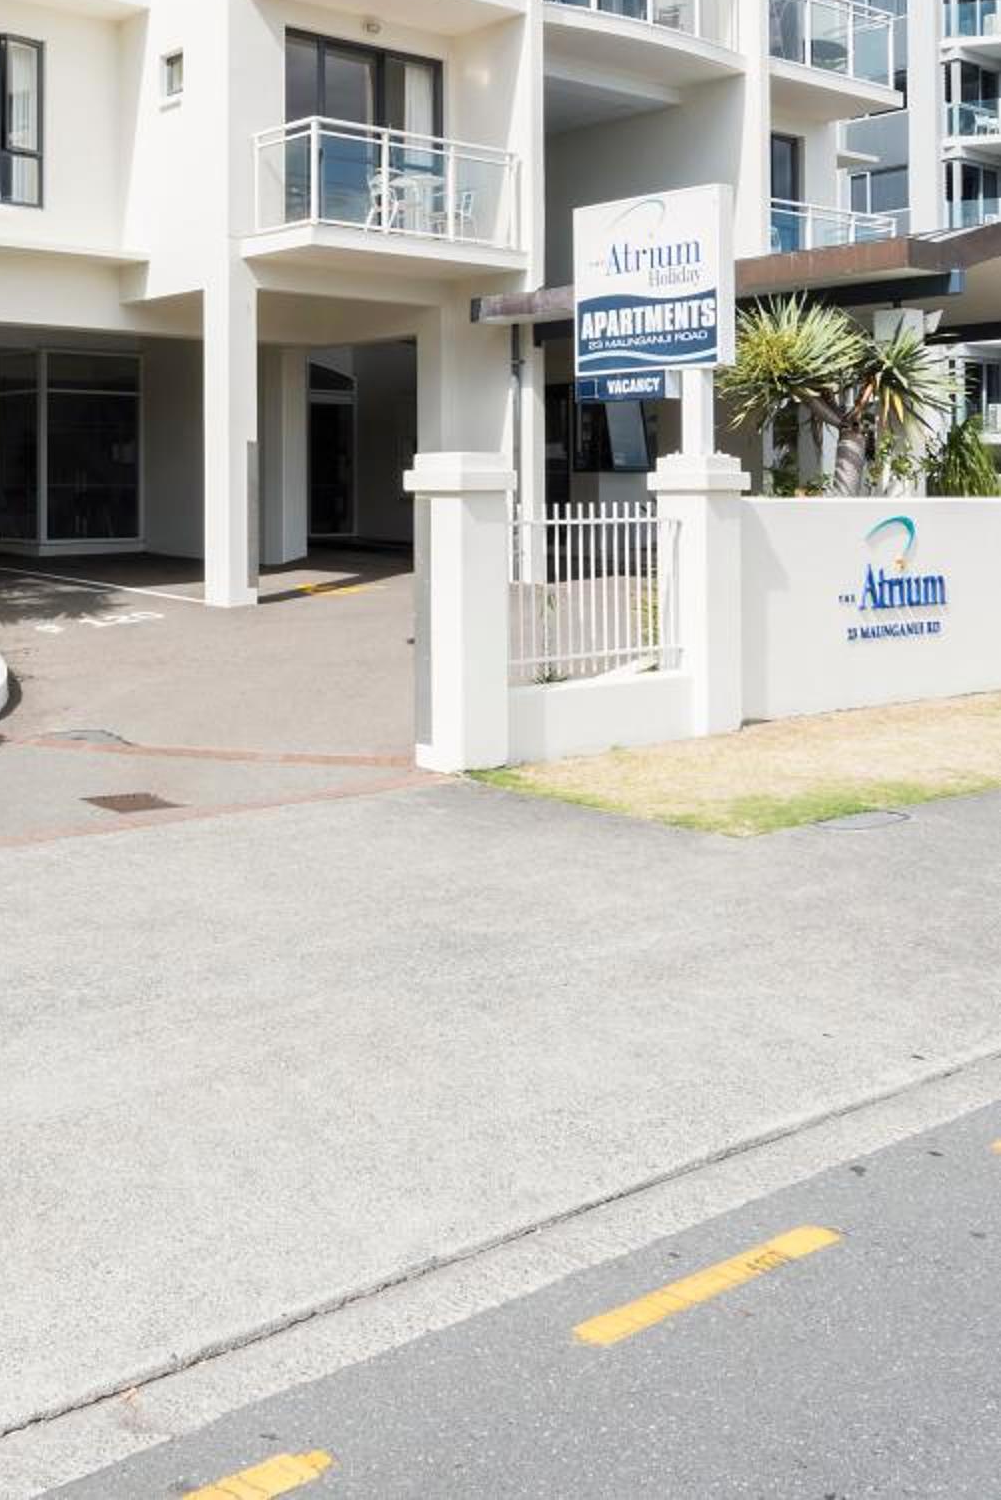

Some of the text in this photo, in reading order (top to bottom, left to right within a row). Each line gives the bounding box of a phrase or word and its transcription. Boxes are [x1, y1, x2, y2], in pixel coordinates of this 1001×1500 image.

[606, 240, 700, 275] Atrium
[649, 266, 700, 288] Holiday
[581, 298, 716, 340] APARTMENTS
[674, 330, 707, 344] ROAD
[606, 377, 660, 394] VACANCY
[859, 564, 946, 610] Atrium
